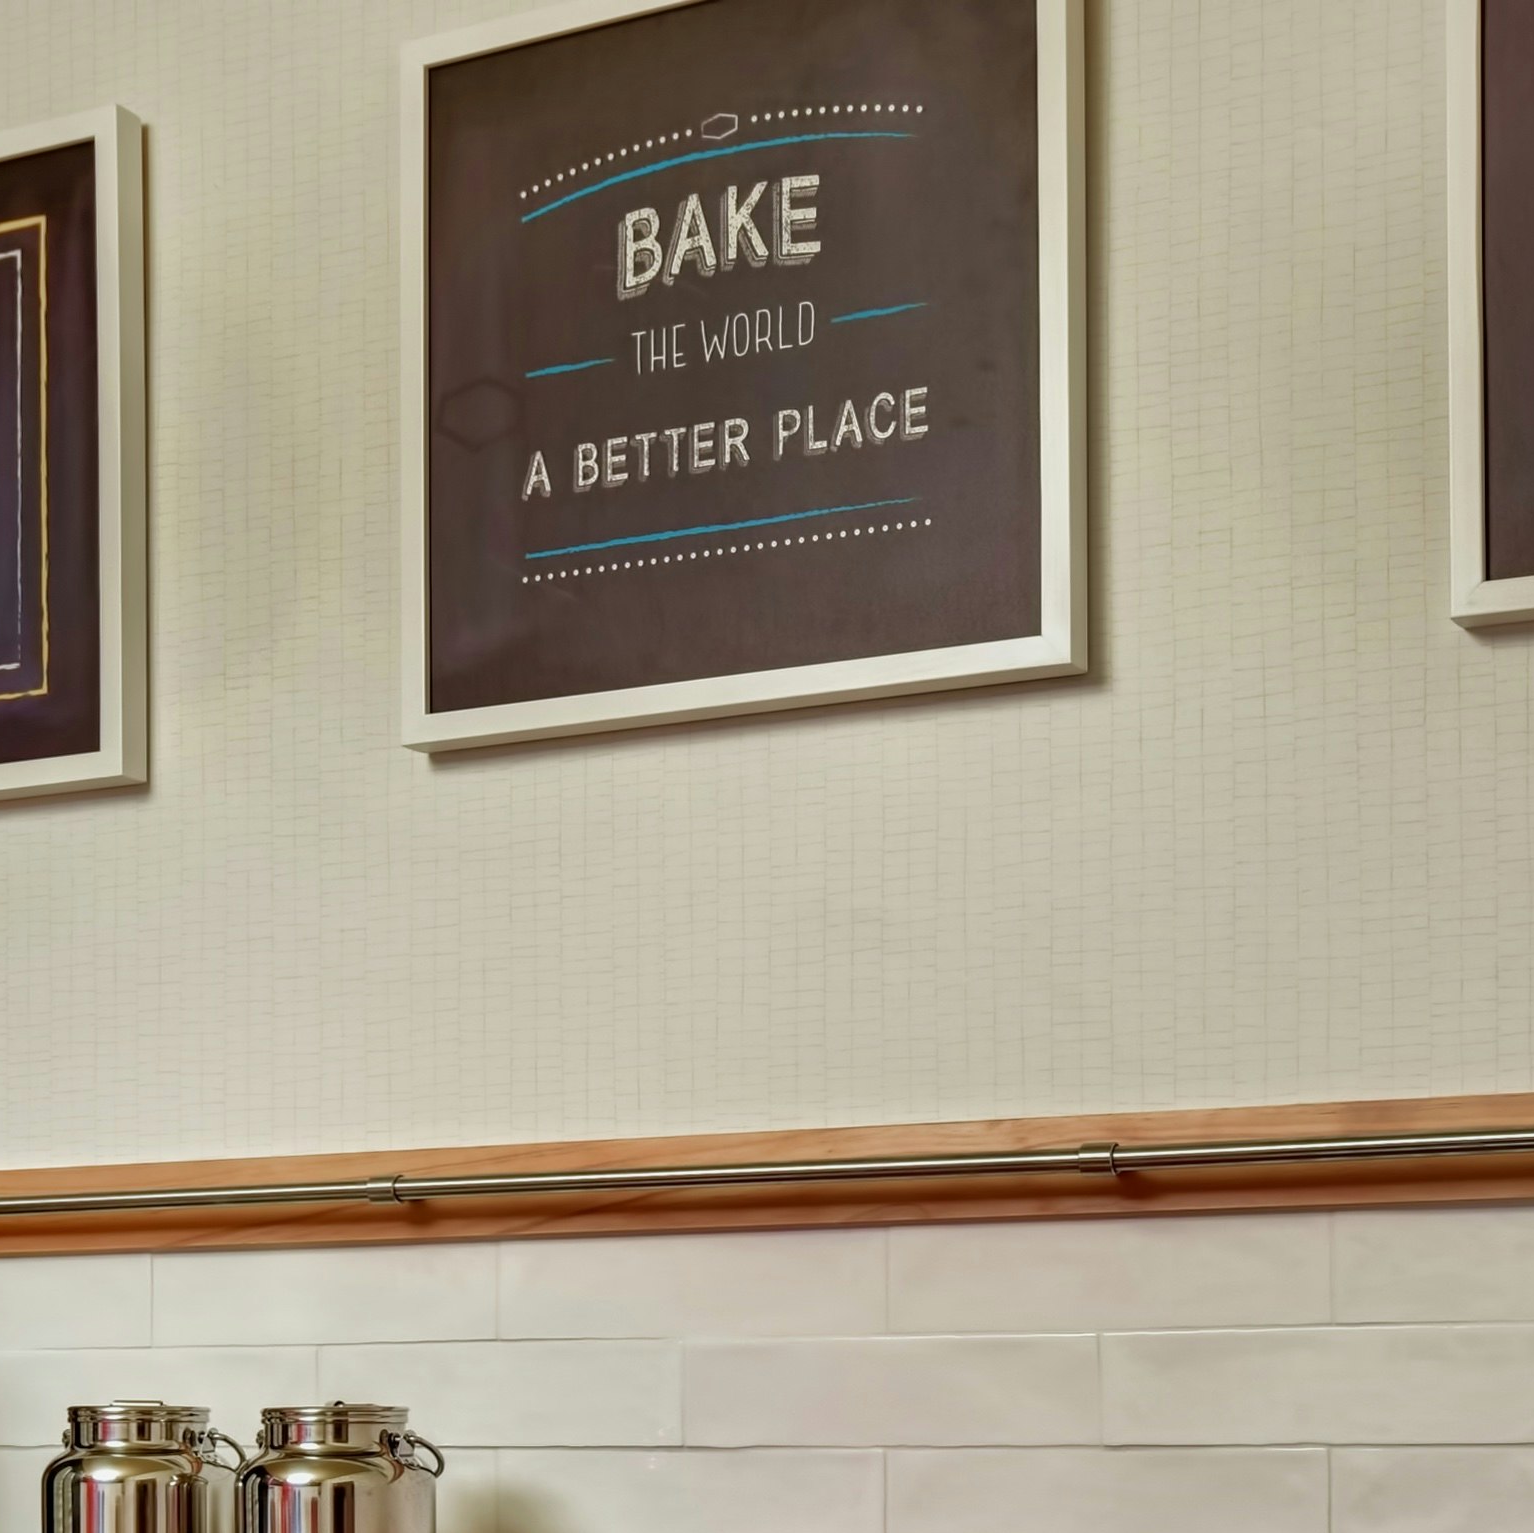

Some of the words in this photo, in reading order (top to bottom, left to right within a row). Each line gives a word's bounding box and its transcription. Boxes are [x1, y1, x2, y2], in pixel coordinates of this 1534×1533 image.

[617, 174, 822, 300] BAKE
[632, 323, 686, 375] THE
[702, 301, 816, 363] WORLD
[522, 450, 552, 501] A
[574, 418, 750, 493] BETTER
[773, 387, 929, 461] PLACE
